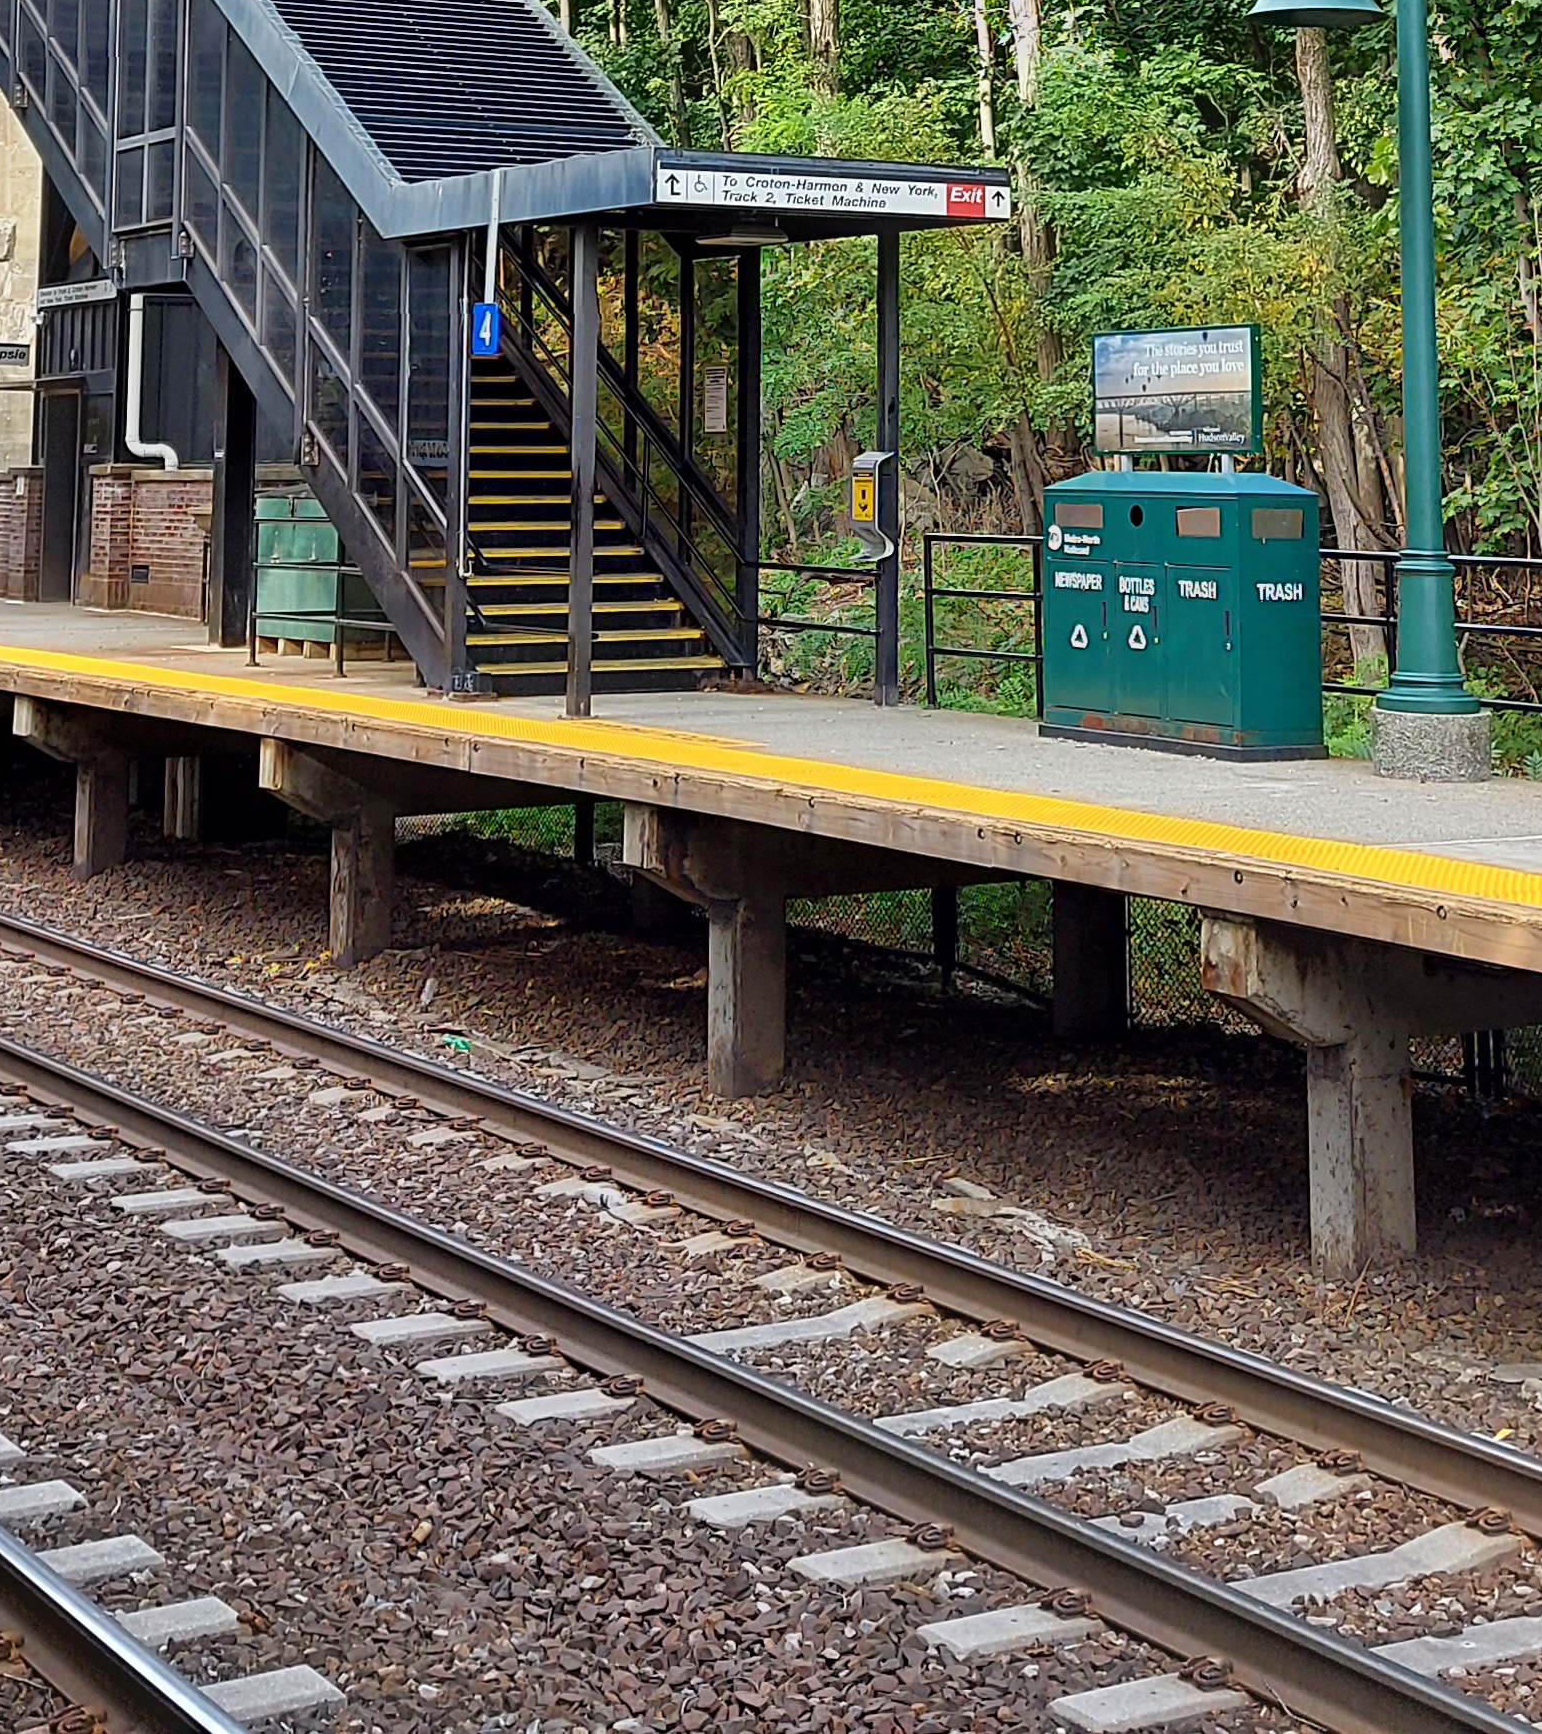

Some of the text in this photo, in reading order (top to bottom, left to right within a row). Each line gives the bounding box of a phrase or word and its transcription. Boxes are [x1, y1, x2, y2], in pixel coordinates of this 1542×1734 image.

[722, 175, 938, 199] To Croton-Harmon & New York,
[950, 186, 983, 204] Exit
[721, 190, 887, 209] Track 2, Ticket Machine
[1144, 340, 1245, 358] The stories you trust
[1133, 358, 1245, 378] for the place you love
[1055, 571, 1103, 591] NEWSPAPER
[1119, 575, 1155, 596] BOTTLES
[1177, 579, 1217, 600] TRASH
[1256, 582, 1303, 601] TRASH
